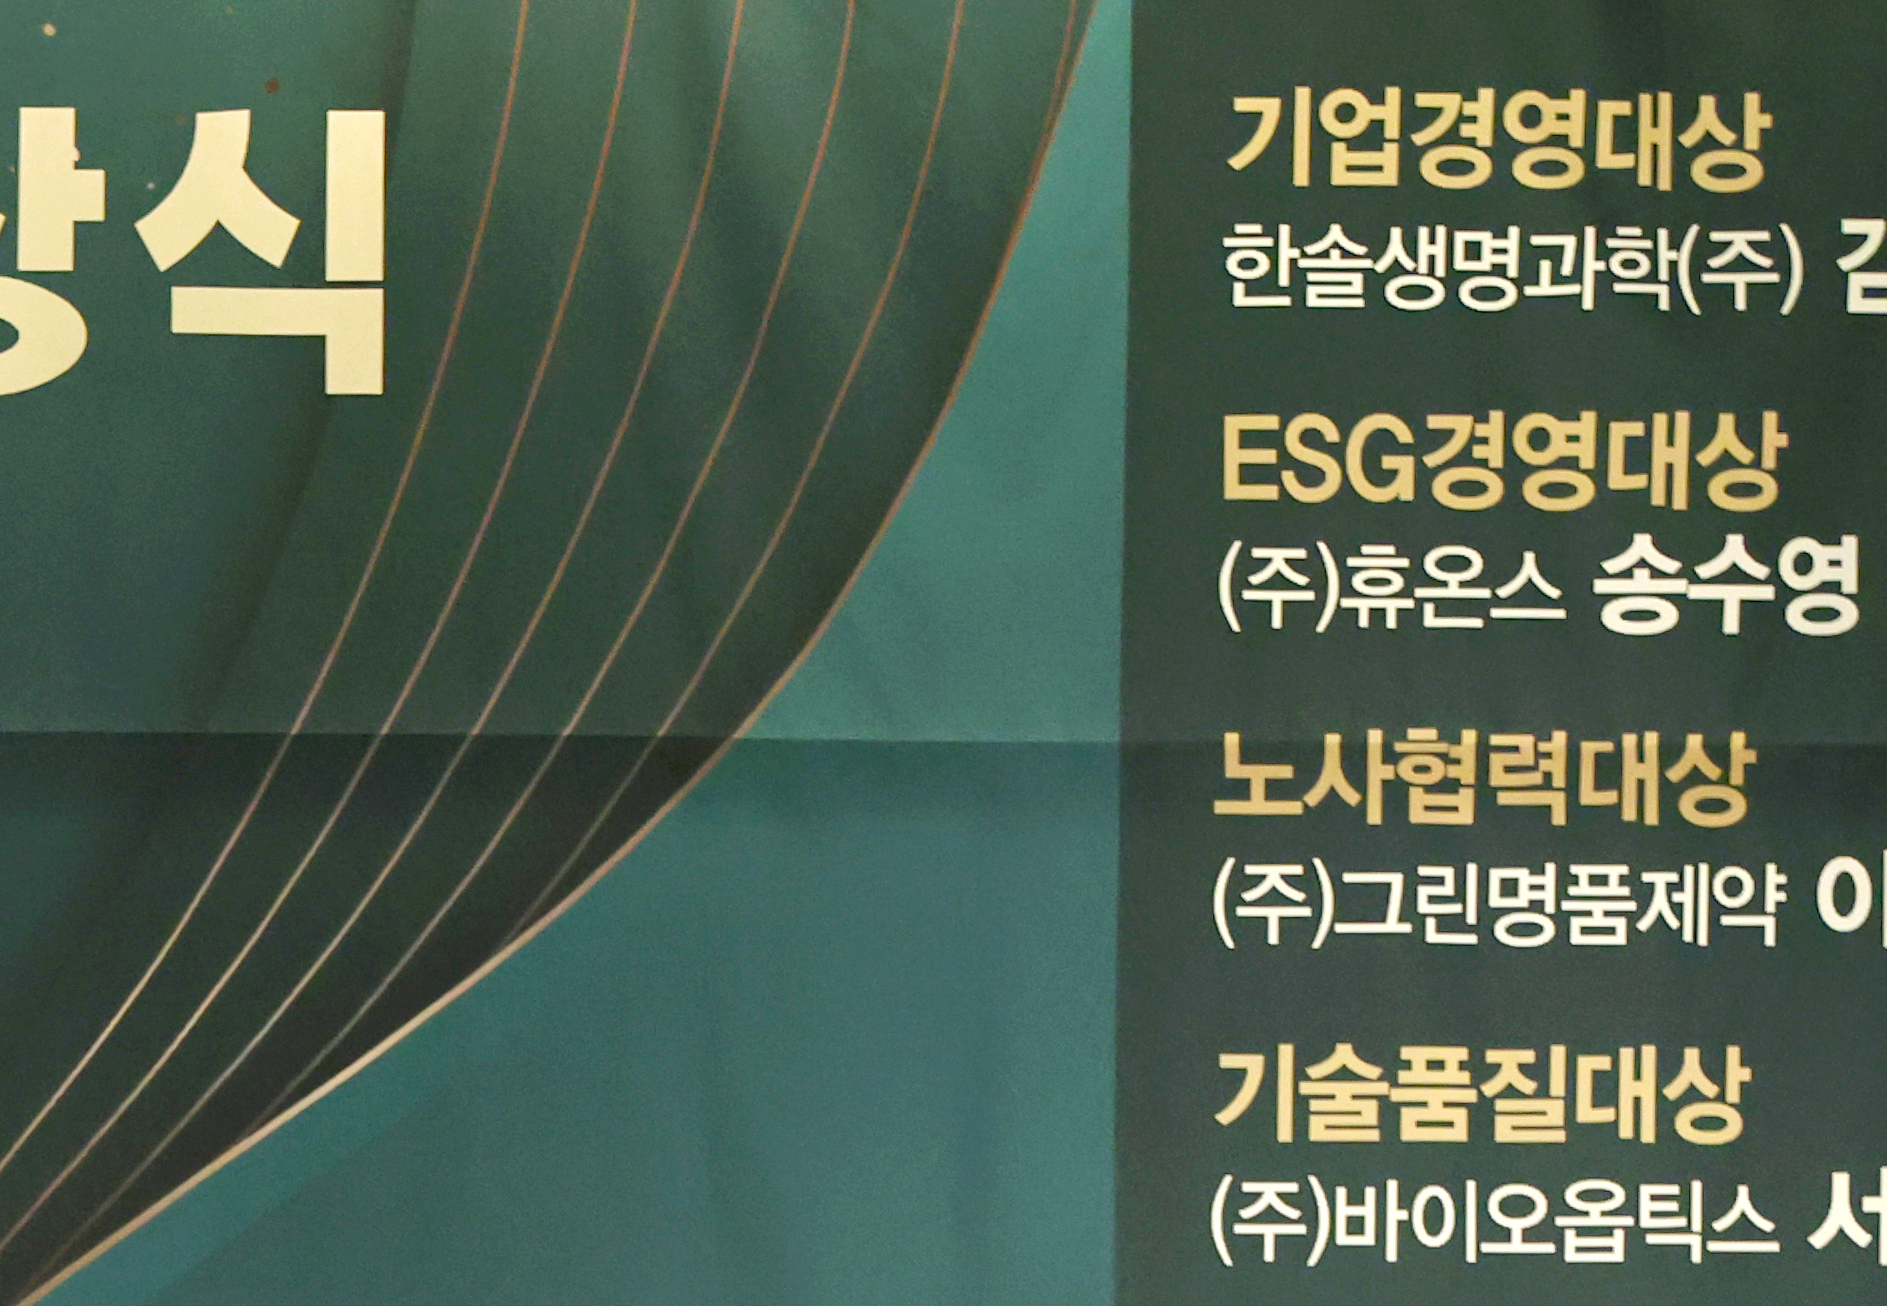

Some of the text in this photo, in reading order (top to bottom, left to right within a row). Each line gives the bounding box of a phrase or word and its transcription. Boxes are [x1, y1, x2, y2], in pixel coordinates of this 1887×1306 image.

[1228, 86, 1772, 192] 기업경영대상
[1223, 224, 1803, 314] 한솔생명과학(주)
[1224, 410, 1788, 511] ESG경영대상
[1220, 533, 1859, 635] (주)휴온스 송수영
[1214, 728, 1756, 827] 노사협력대상
[1214, 857, 1787, 949] (주)그린명품제약
[1215, 1043, 1752, 1144] 기술품질대상
[1211, 1175, 1780, 1266] (주)바이오옵틱스
